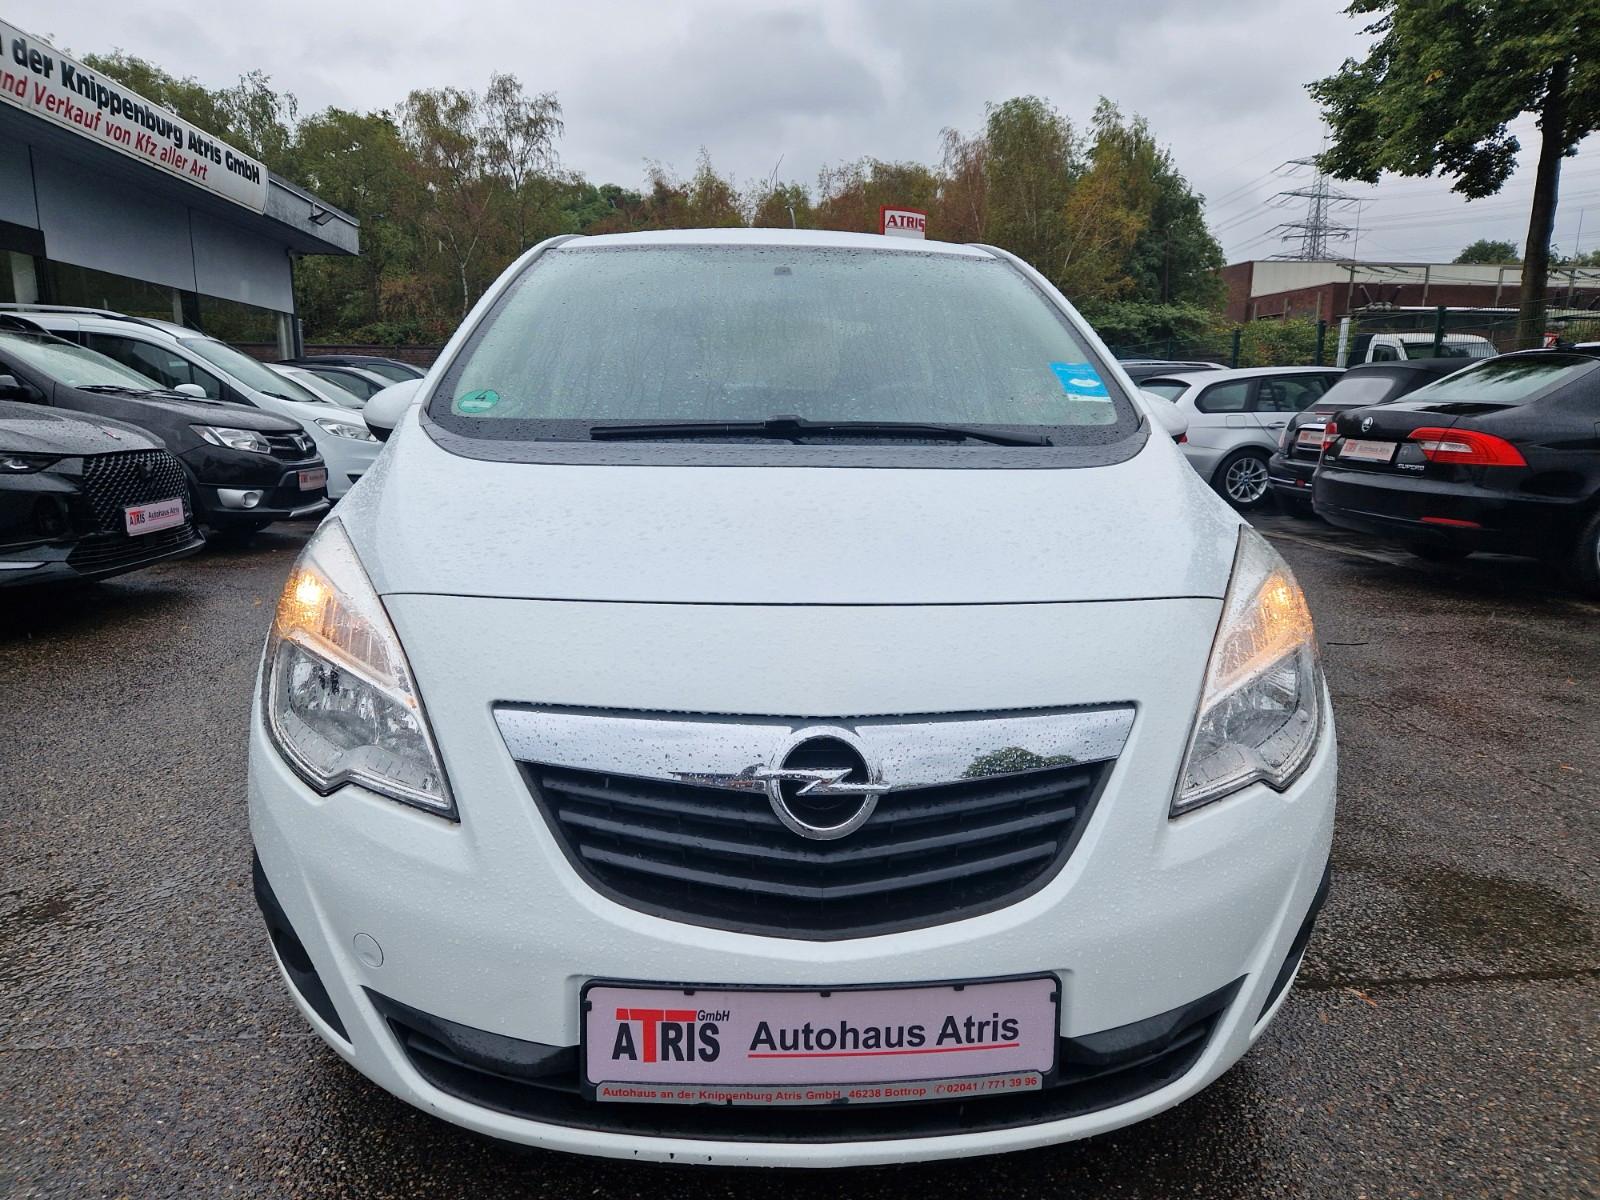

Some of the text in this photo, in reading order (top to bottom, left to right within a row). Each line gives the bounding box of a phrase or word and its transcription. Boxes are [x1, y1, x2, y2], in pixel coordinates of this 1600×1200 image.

[12, 37, 53, 79] der
[61, 61, 183, 149] Knippenburg
[188, 129, 222, 165] Atris
[225, 150, 260, 184] GmbH
[35, 81, 102, 131] Verkauf
[106, 121, 131, 145] von
[135, 131, 158, 157] Kfz
[160, 146, 188, 170] aller
[189, 159, 208, 180] Art
[886, 214, 925, 232] ATRIS
[697, 1010, 730, 1021] GmbH
[750, 1012, 1020, 1051] Autohaus Atris
[611, 1008, 721, 1063] ATRIS
[602, 1087, 656, 1098] Autohaus
[660, 1090, 674, 1099] an
[677, 1089, 696, 1099] der
[699, 1090, 772, 1103] Knippenburg
[775, 1090, 802, 1101] Atris
[806, 1089, 841, 1100] GmbH
[848, 1088, 881, 1099] 46238
[885, 1086, 927, 1099] Bottrop
[946, 1082, 978, 1093] 02041
[988, 1078, 1006, 1089] 771
[1009, 1077, 1022, 1088] 39
[1024, 1076, 1037, 1087] 96
